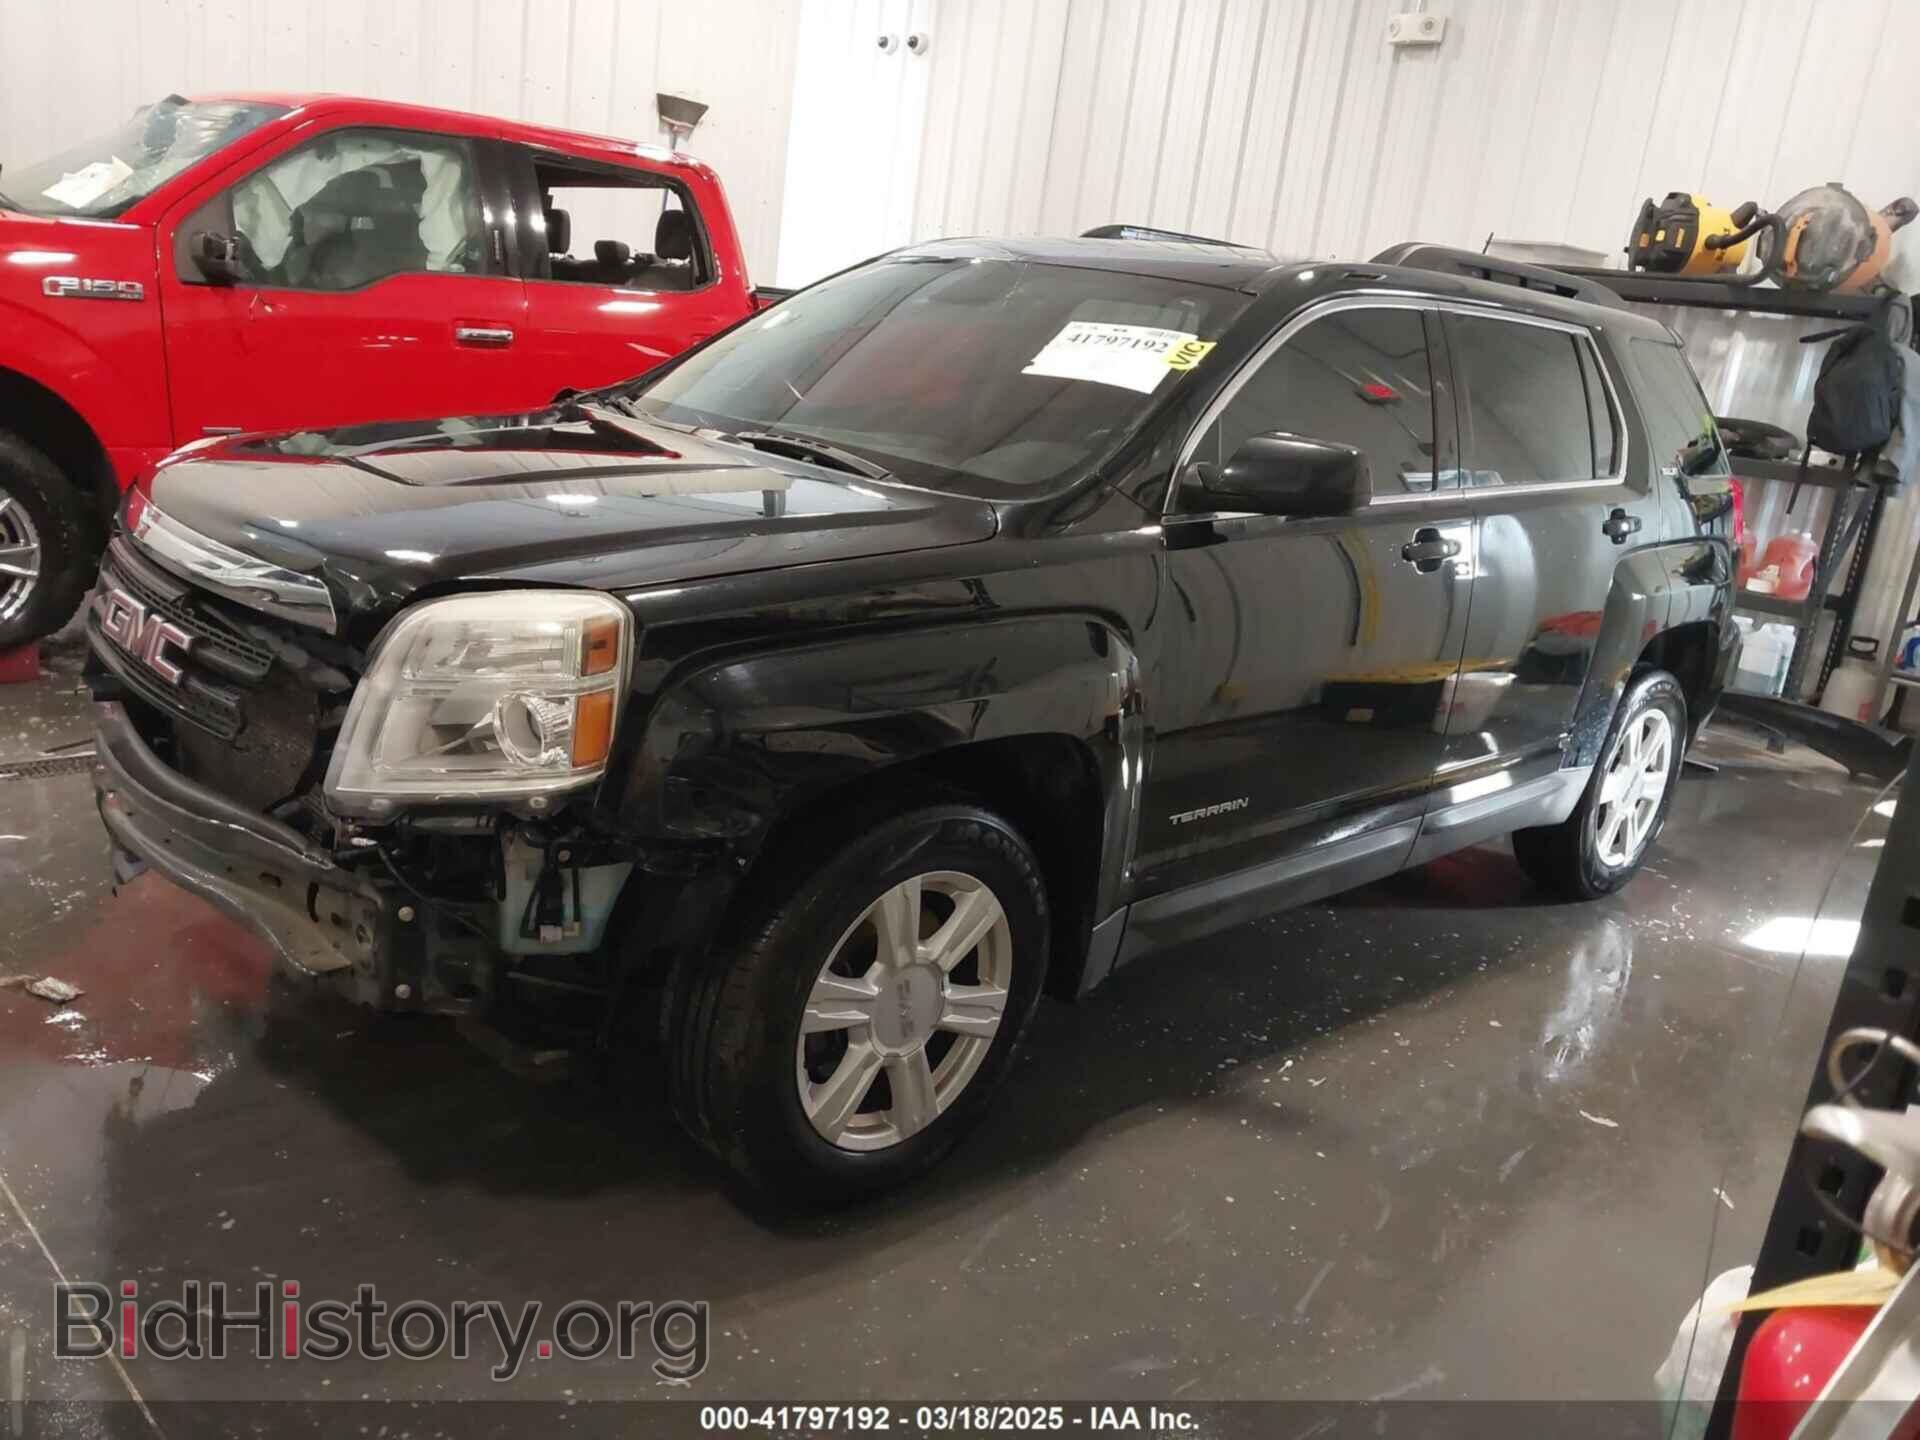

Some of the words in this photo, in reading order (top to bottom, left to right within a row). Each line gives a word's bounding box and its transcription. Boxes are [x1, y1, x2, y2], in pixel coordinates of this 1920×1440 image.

[1067, 332, 1169, 353] 41797192
[1168, 341, 1206, 366] VIC
[101, 588, 193, 685] GMC
[1169, 797, 1249, 825] TERRAIN
